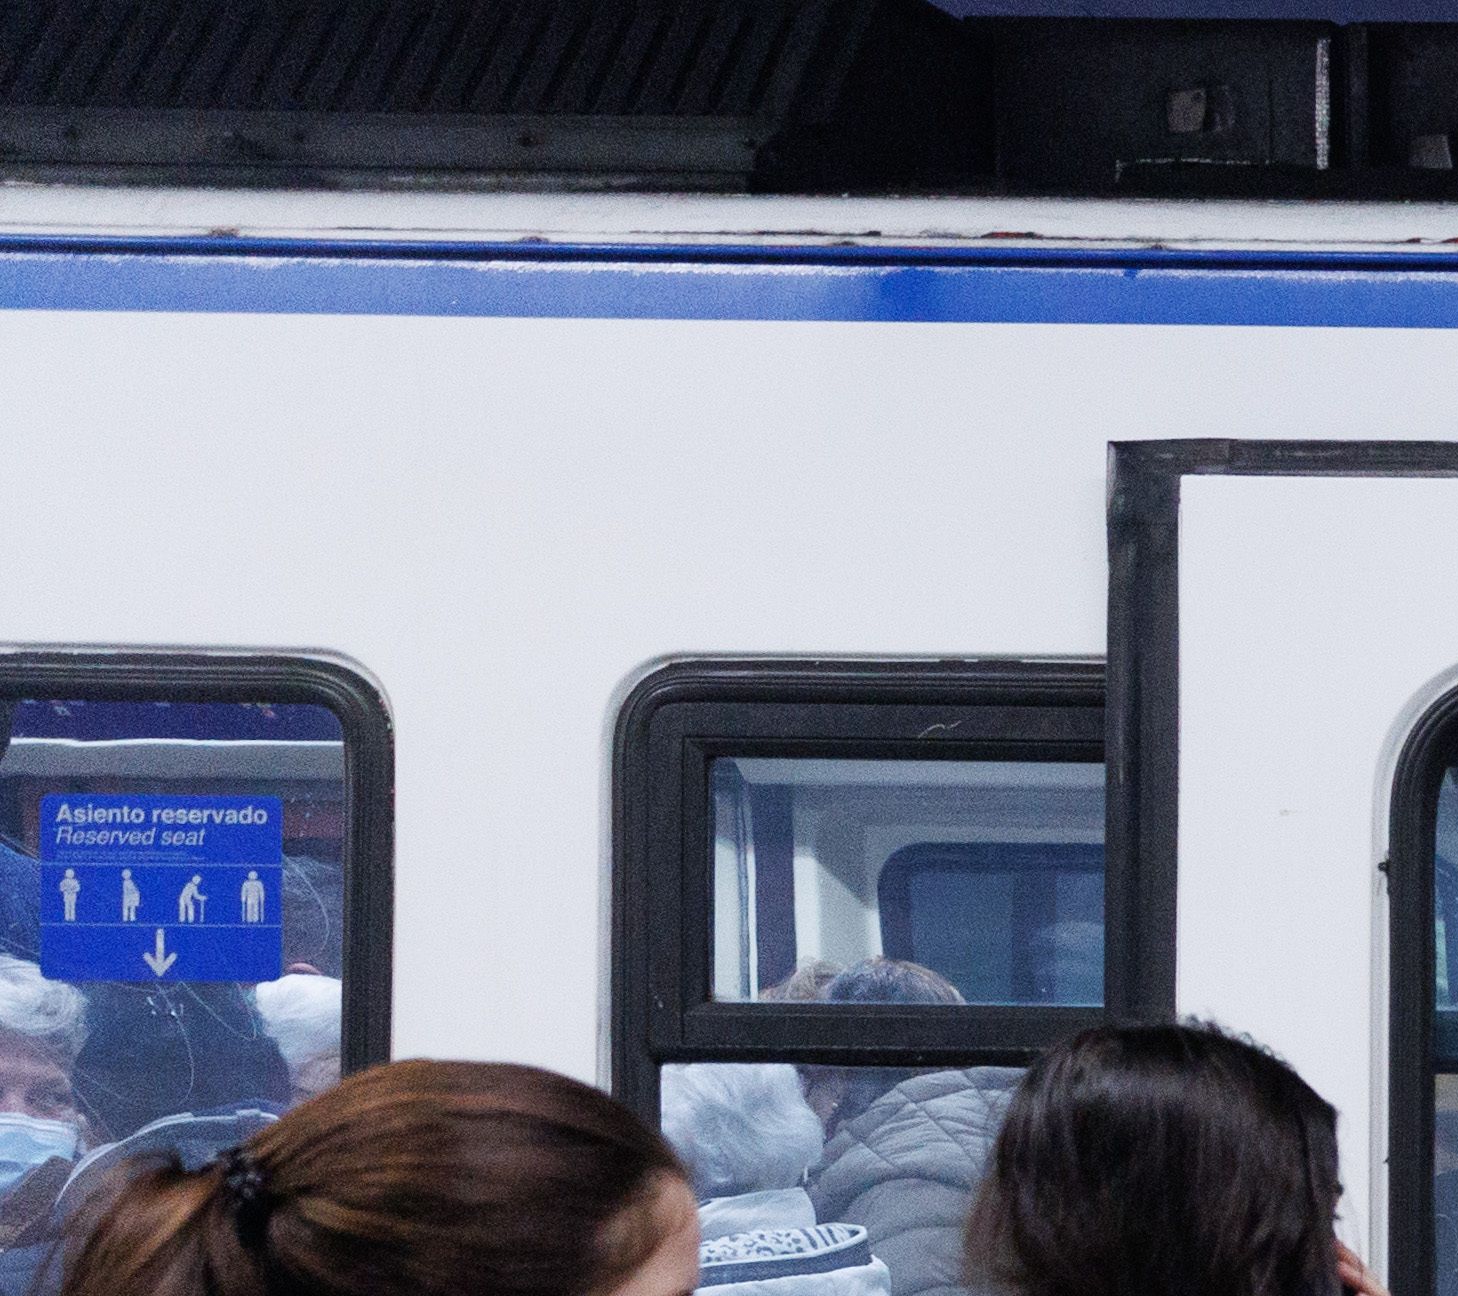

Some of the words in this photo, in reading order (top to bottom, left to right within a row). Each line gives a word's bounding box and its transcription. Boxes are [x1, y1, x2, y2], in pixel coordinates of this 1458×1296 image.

[56, 803, 145, 824] Asiento
[152, 804, 268, 825] reservado
[56, 825, 156, 845] Reserved
[161, 828, 206, 846] seat
